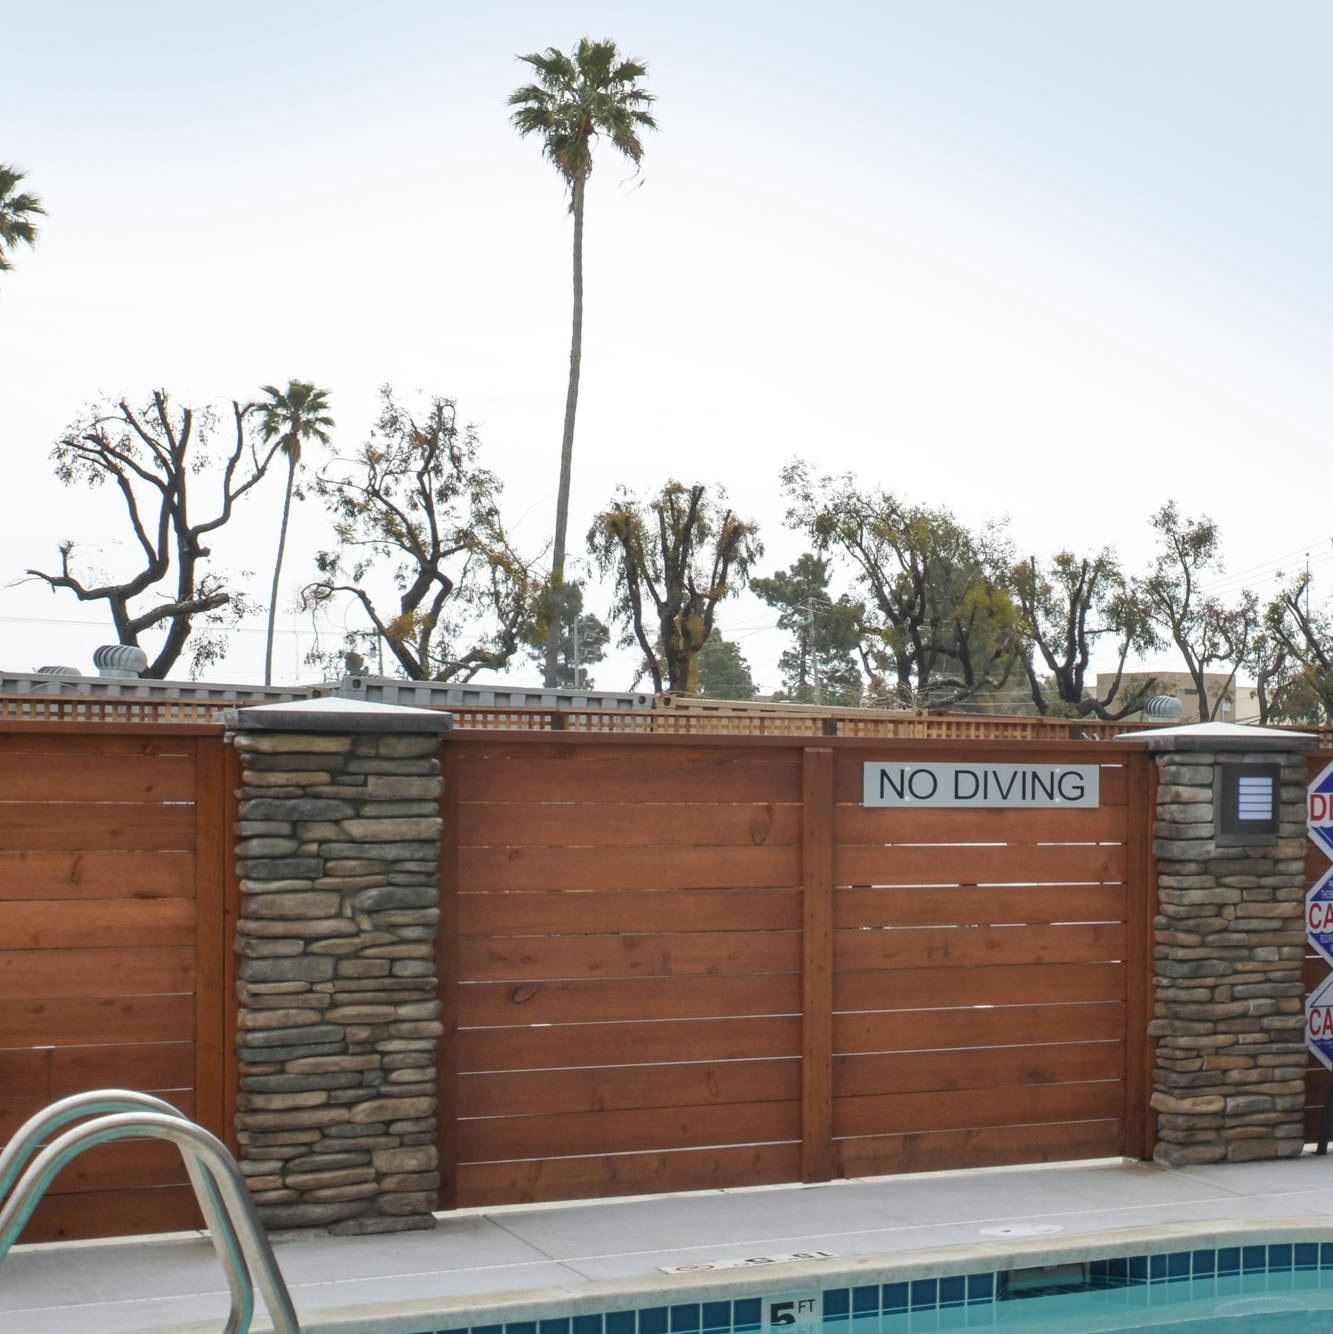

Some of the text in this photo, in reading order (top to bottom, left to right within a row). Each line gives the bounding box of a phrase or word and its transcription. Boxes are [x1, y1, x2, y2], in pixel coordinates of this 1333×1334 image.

[879, 768, 1086, 801] NO DIVING
[769, 1298, 816, 1326] 5 FT
